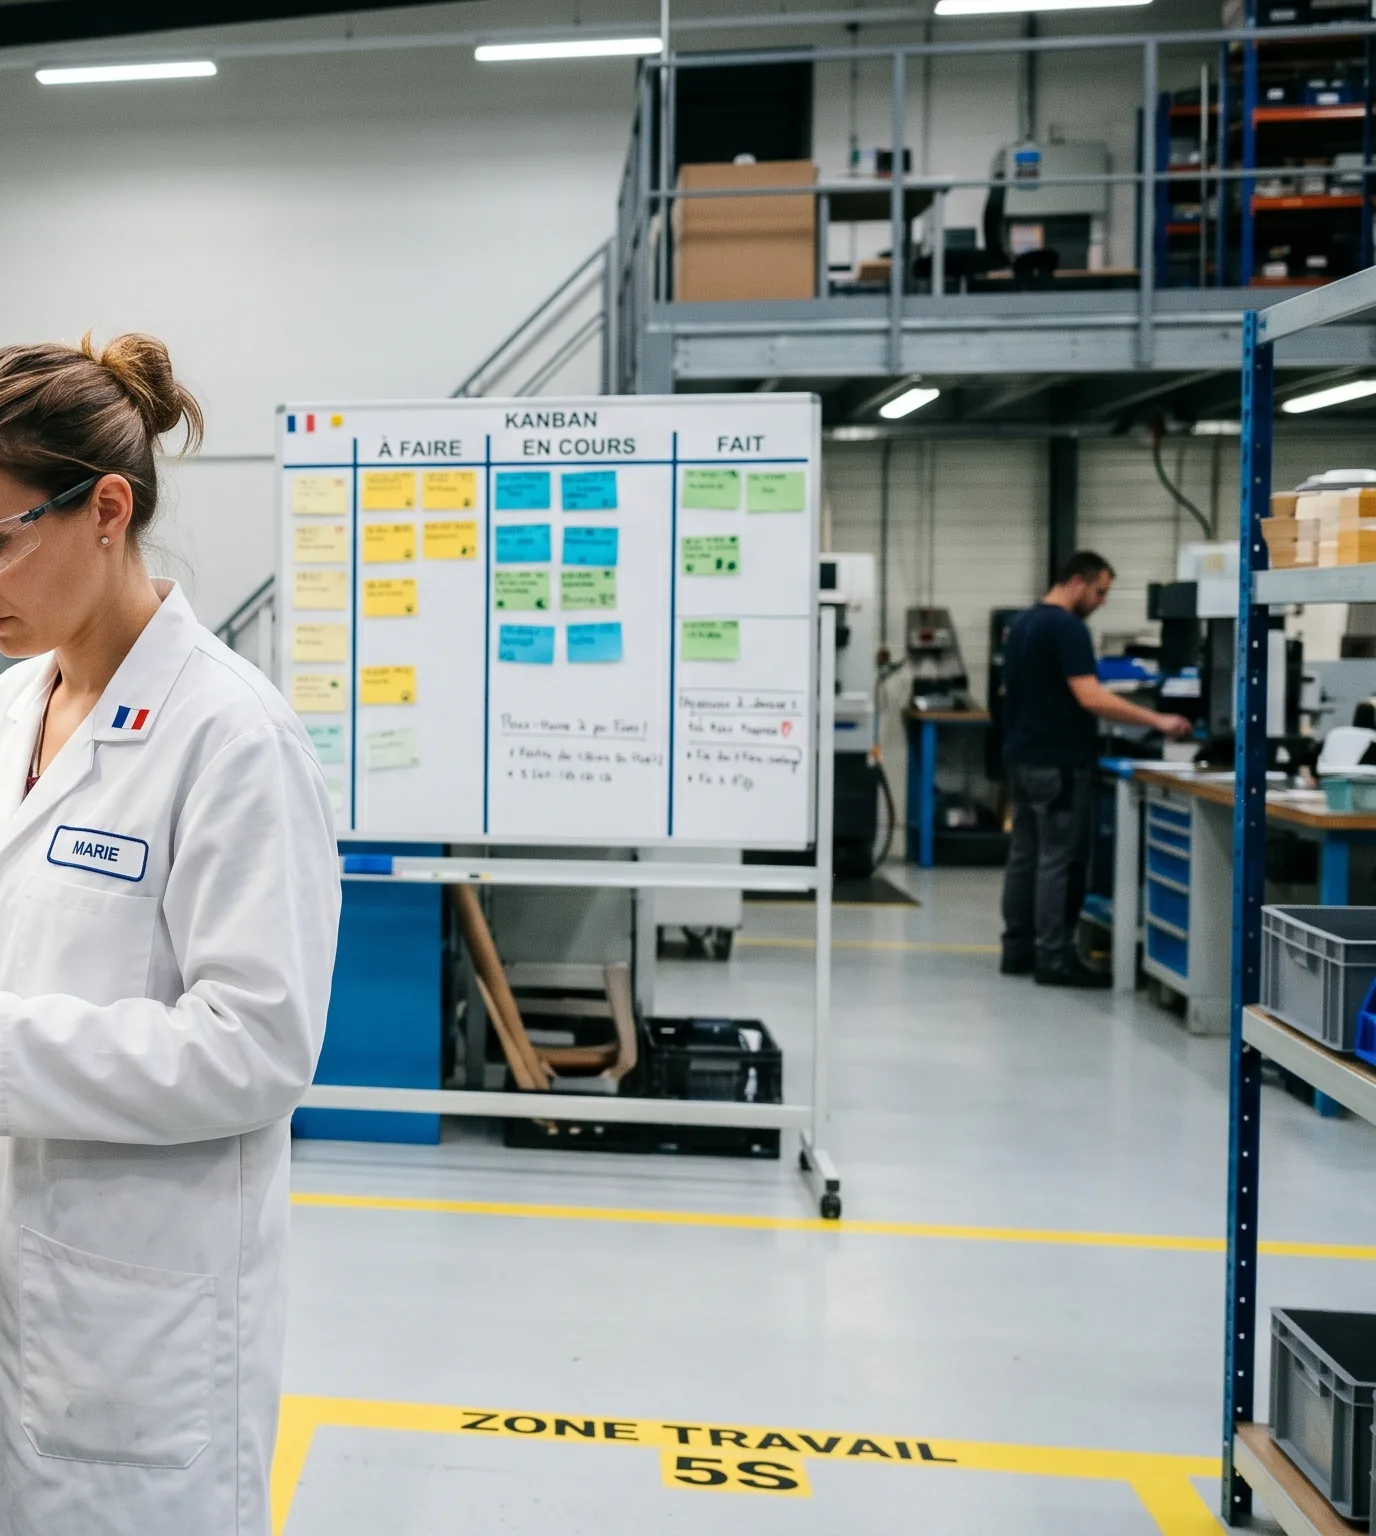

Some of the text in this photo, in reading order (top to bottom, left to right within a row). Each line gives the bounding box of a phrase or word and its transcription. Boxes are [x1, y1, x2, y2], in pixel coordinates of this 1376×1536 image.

[504, 412, 598, 429] KANBAN
[378, 436, 462, 457] À FAIRE
[523, 438, 636, 456] EN COURS
[717, 436, 765, 453] FAIT
[72, 840, 120, 862] MARIE
[460, 1412, 959, 1463] ZONE TRAVAIL
[673, 1457, 799, 1490] 5S
